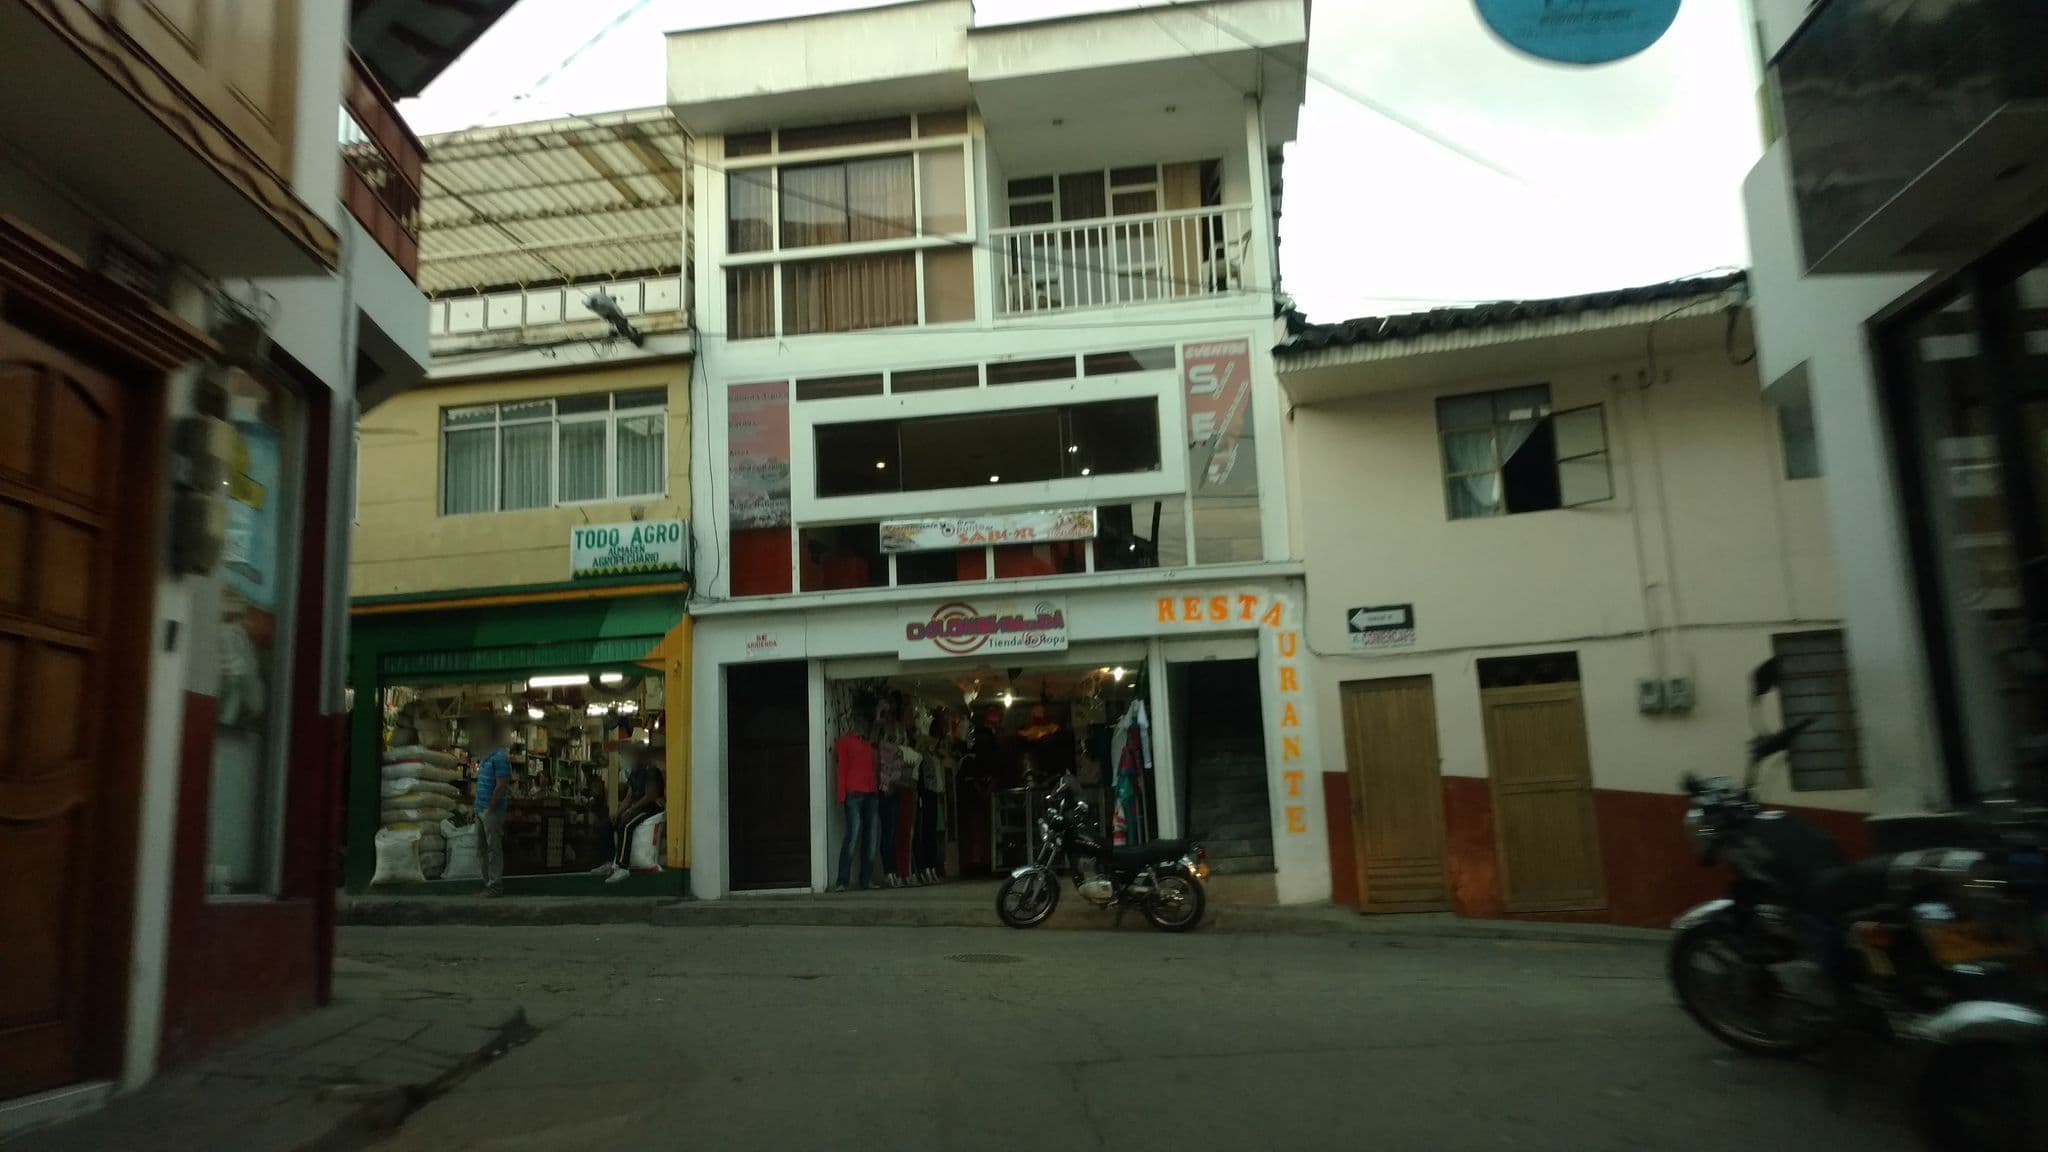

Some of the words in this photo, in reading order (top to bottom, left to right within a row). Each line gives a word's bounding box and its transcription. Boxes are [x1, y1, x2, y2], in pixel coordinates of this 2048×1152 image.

[575, 528, 620, 550] TODO
[630, 523, 680, 546] AGRO
[592, 552, 660, 568] AGROPECUARIO
[989, 637, 1023, 648] Tienda
